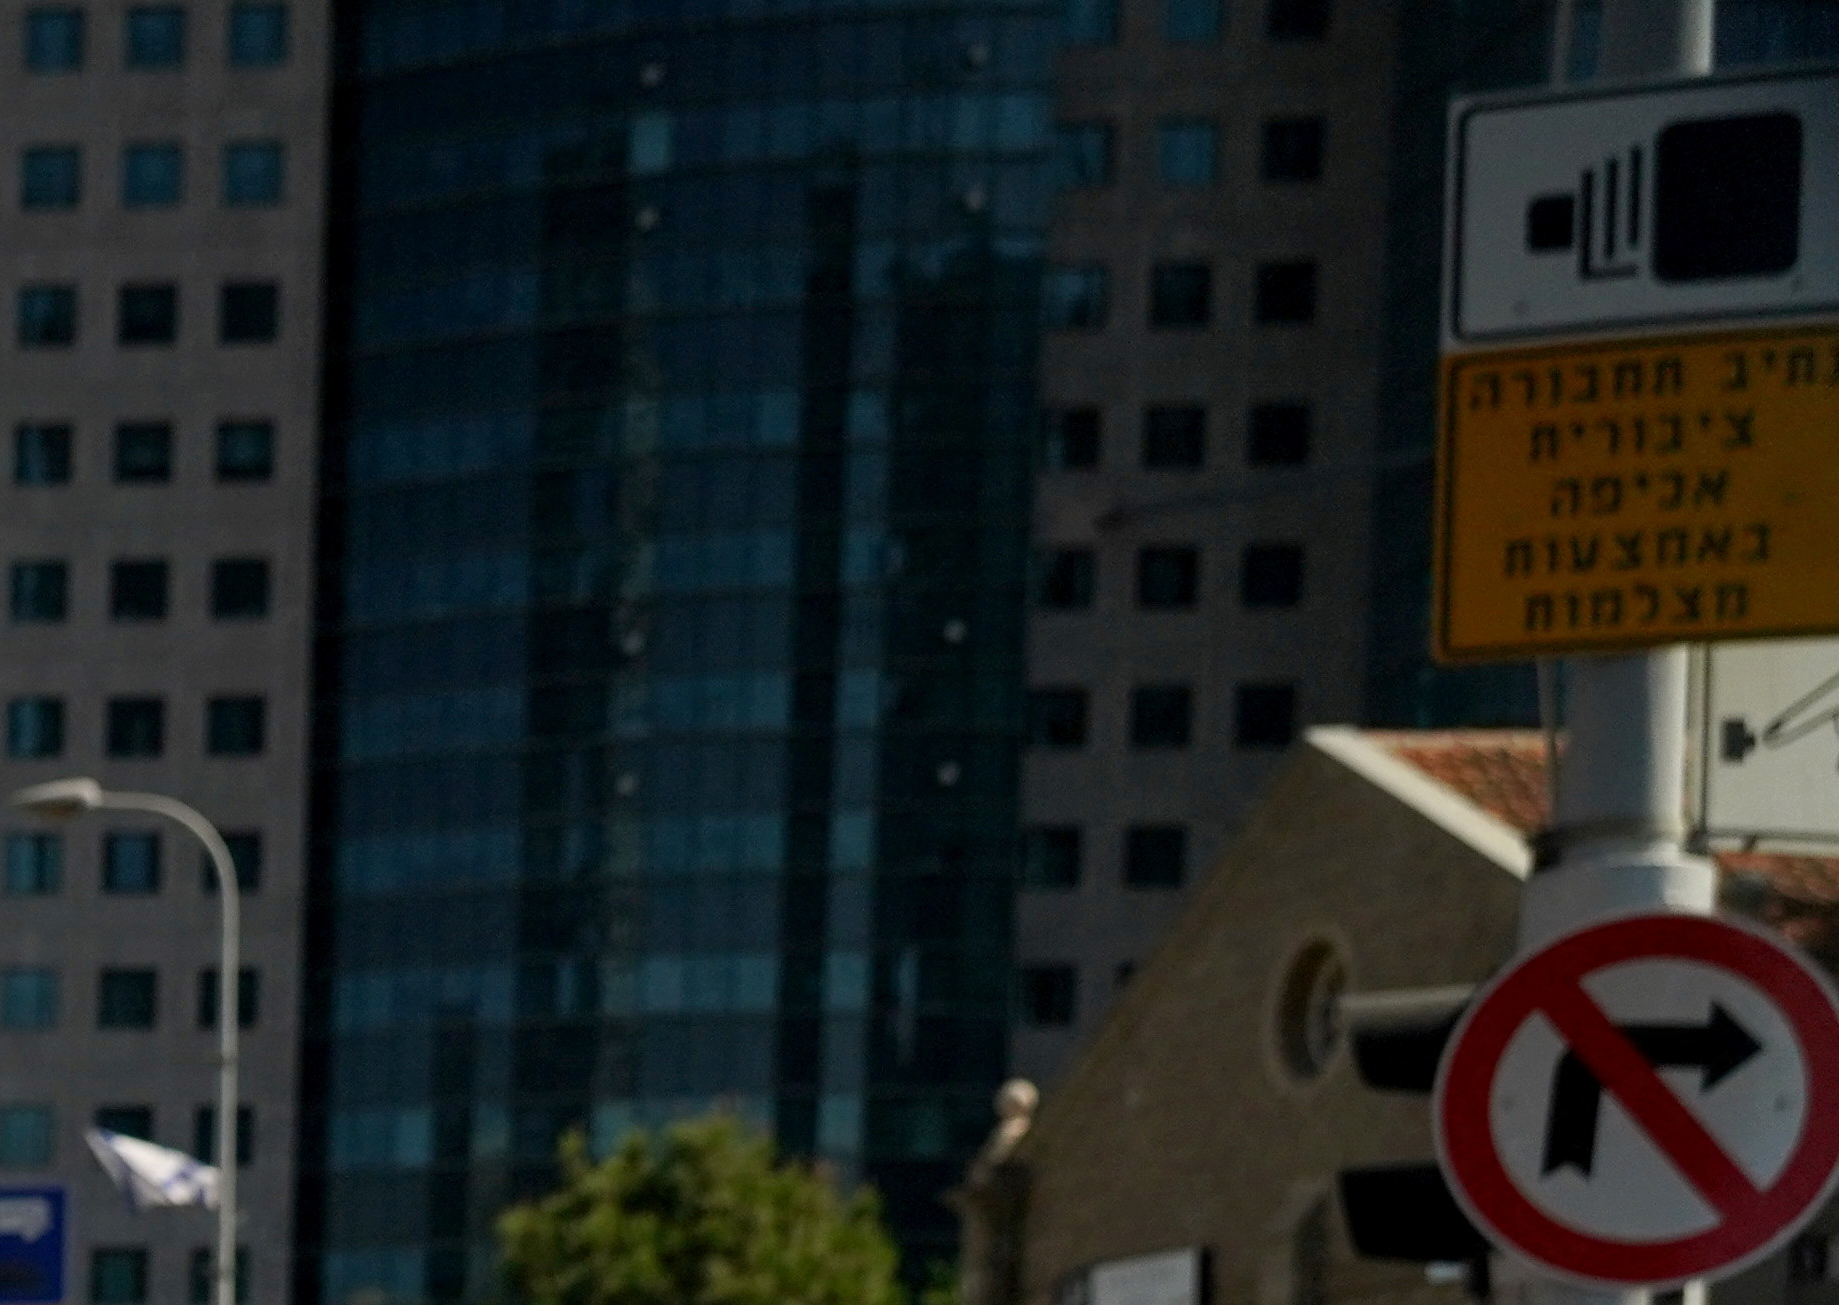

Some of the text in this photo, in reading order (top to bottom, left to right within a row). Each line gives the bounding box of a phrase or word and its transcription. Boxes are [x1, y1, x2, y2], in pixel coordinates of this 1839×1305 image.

[1470, 356, 1683, 411] תחבורה
[1529, 409, 1756, 461] ציבורית
[1549, 469, 1730, 517] אכיפה
[1504, 522, 1772, 577] באמצעות
[1525, 583, 1749, 631] מצלמות
